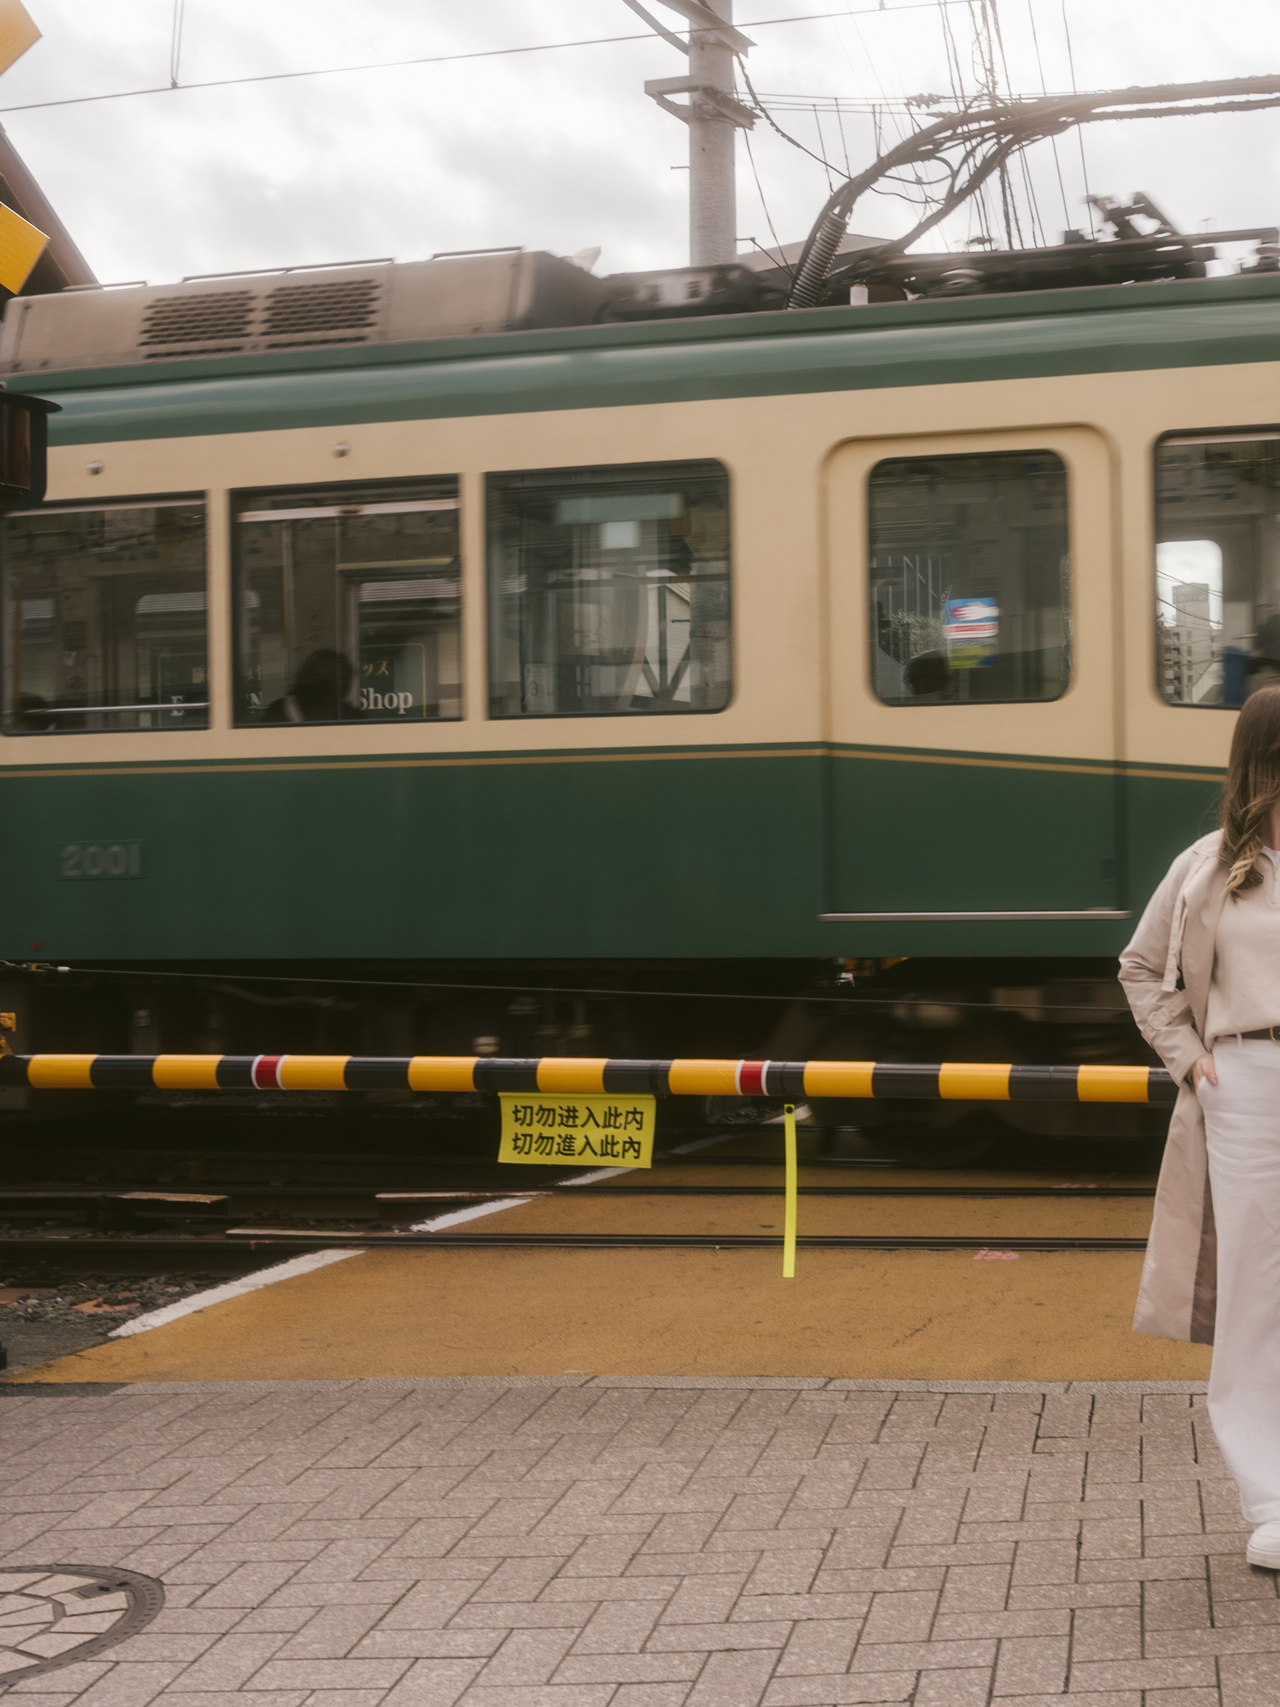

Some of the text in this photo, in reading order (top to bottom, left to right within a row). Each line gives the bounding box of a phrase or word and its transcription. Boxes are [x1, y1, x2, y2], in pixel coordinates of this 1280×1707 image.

[359, 687, 413, 715] Shop
[60, 843, 141, 876] 2001
[512, 1104, 644, 1131] 切勿进入此内
